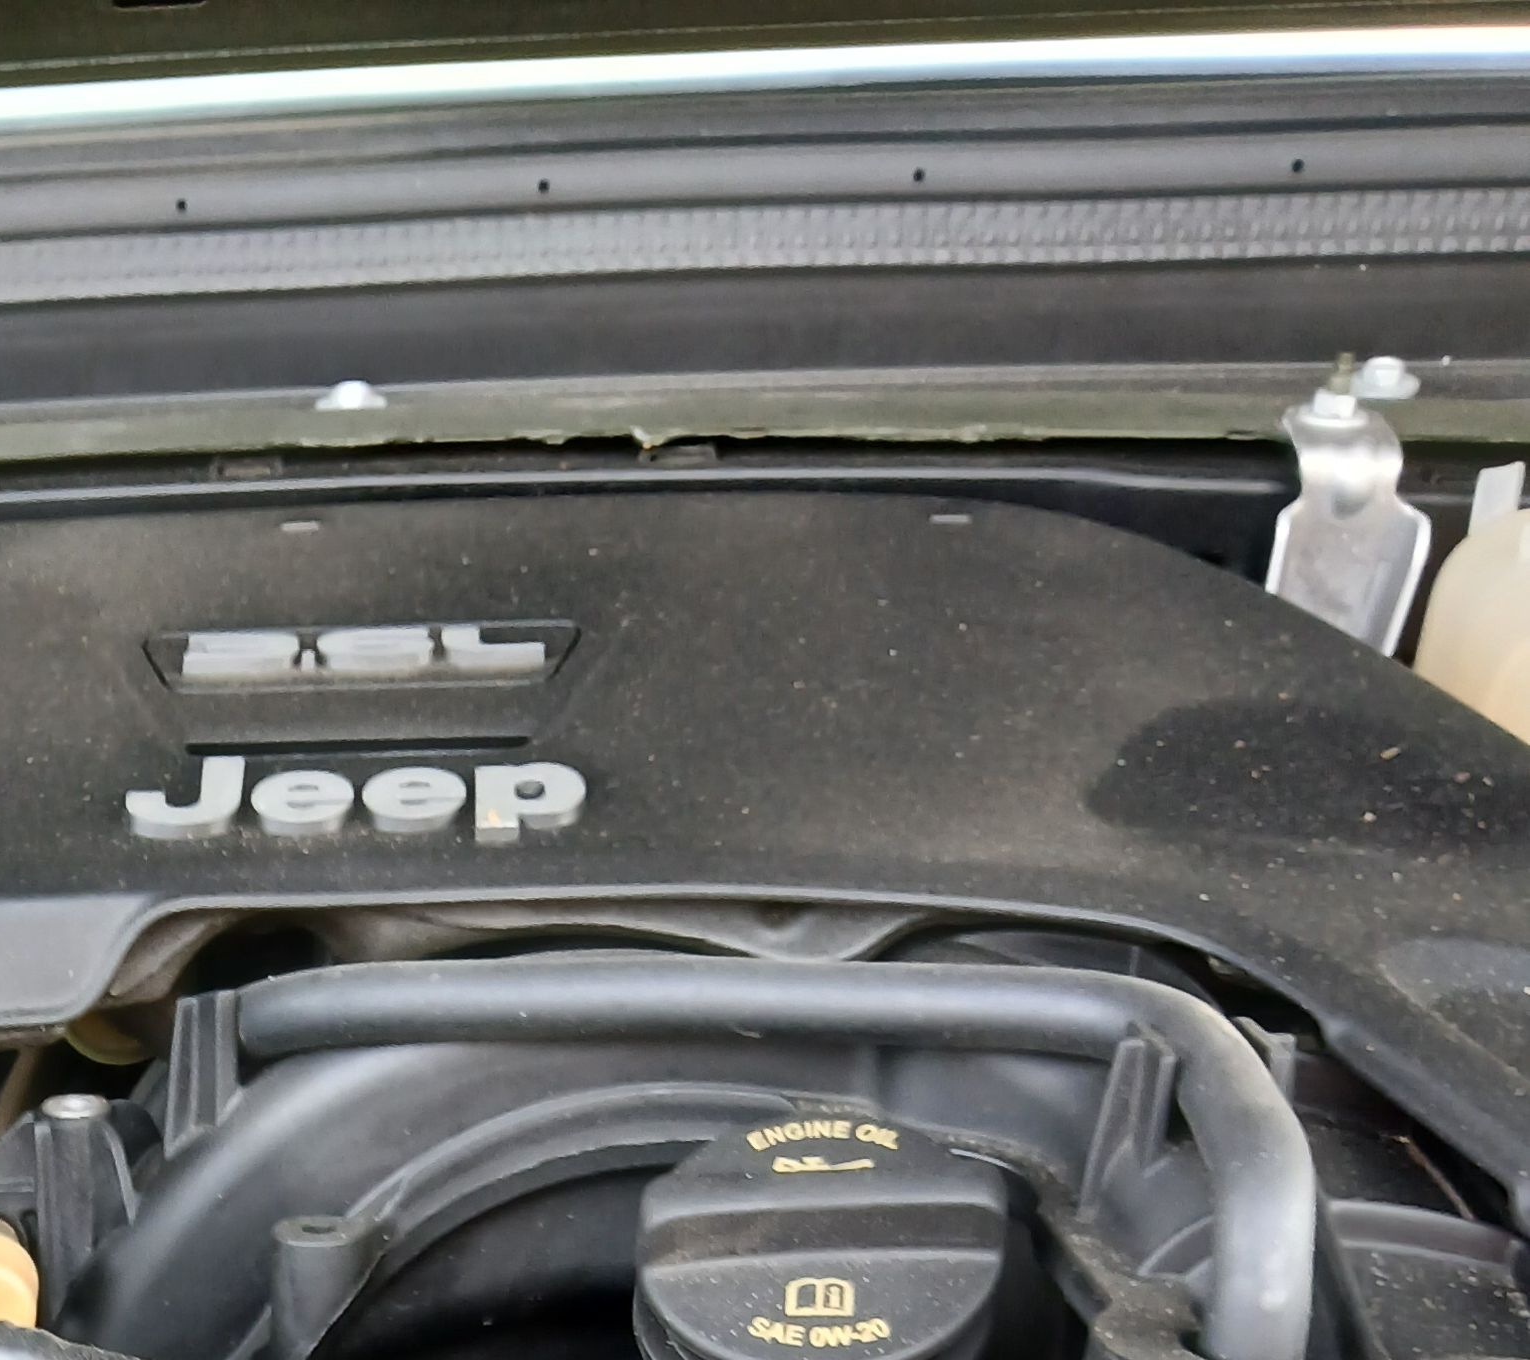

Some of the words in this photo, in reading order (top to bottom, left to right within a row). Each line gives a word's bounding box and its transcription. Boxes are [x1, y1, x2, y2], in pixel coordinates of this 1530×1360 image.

[125, 756, 587, 843] Jeep
[746, 1120, 852, 1152] ENGINE
[855, 1123, 899, 1150] OIL
[747, 1316, 807, 1347] SAE
[808, 1317, 890, 1348] 0W-20
